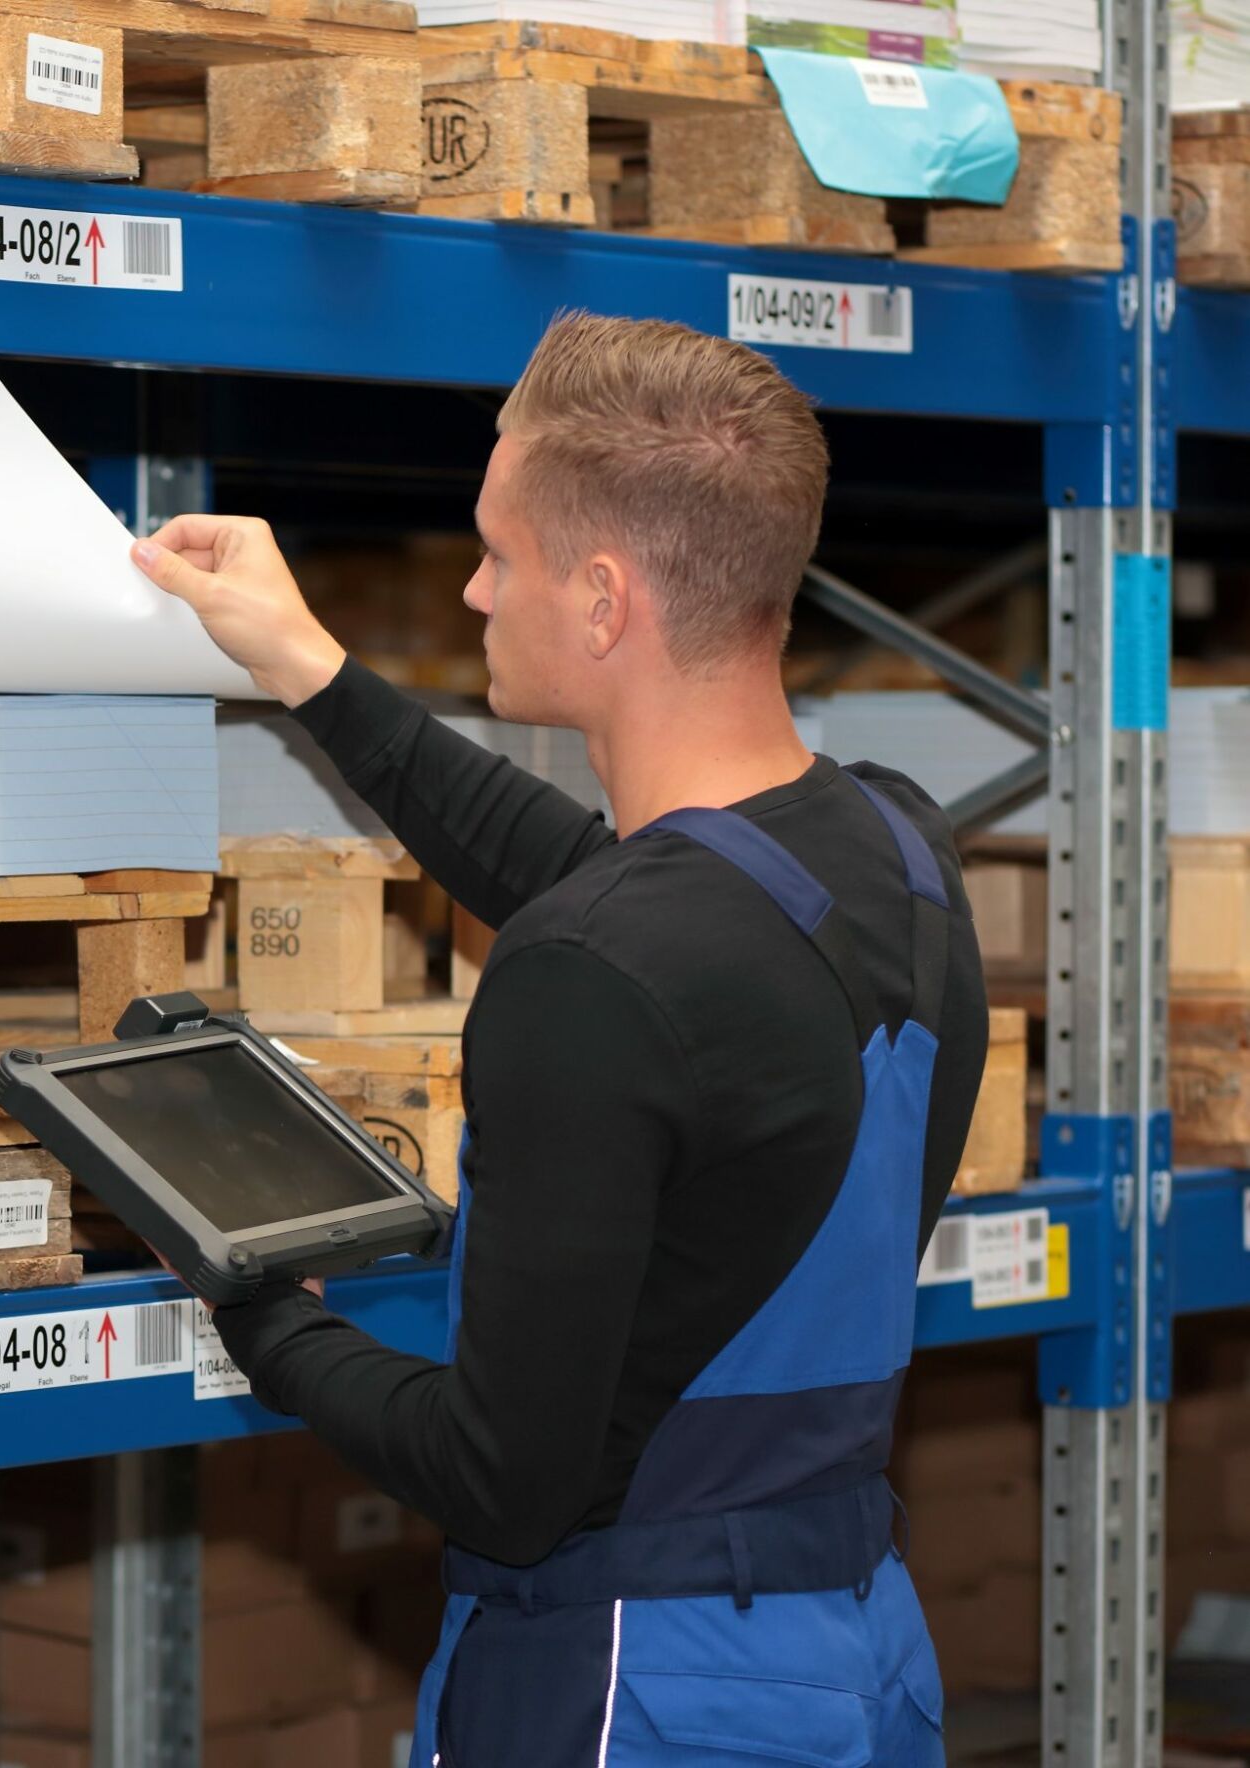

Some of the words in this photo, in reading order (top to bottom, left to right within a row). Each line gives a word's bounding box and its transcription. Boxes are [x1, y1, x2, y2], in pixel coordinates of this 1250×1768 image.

[421, 114, 467, 166] UR
[25, 272, 40, 281] Fach
[57, 274, 76, 283] Ebene
[734, 285, 835, 330] 1/04-09/2
[250, 906, 301, 931] 650
[250, 932, 301, 957] 890
[38, 1377, 54, 1386] Fach
[70, 1374, 89, 1383] Ebene
